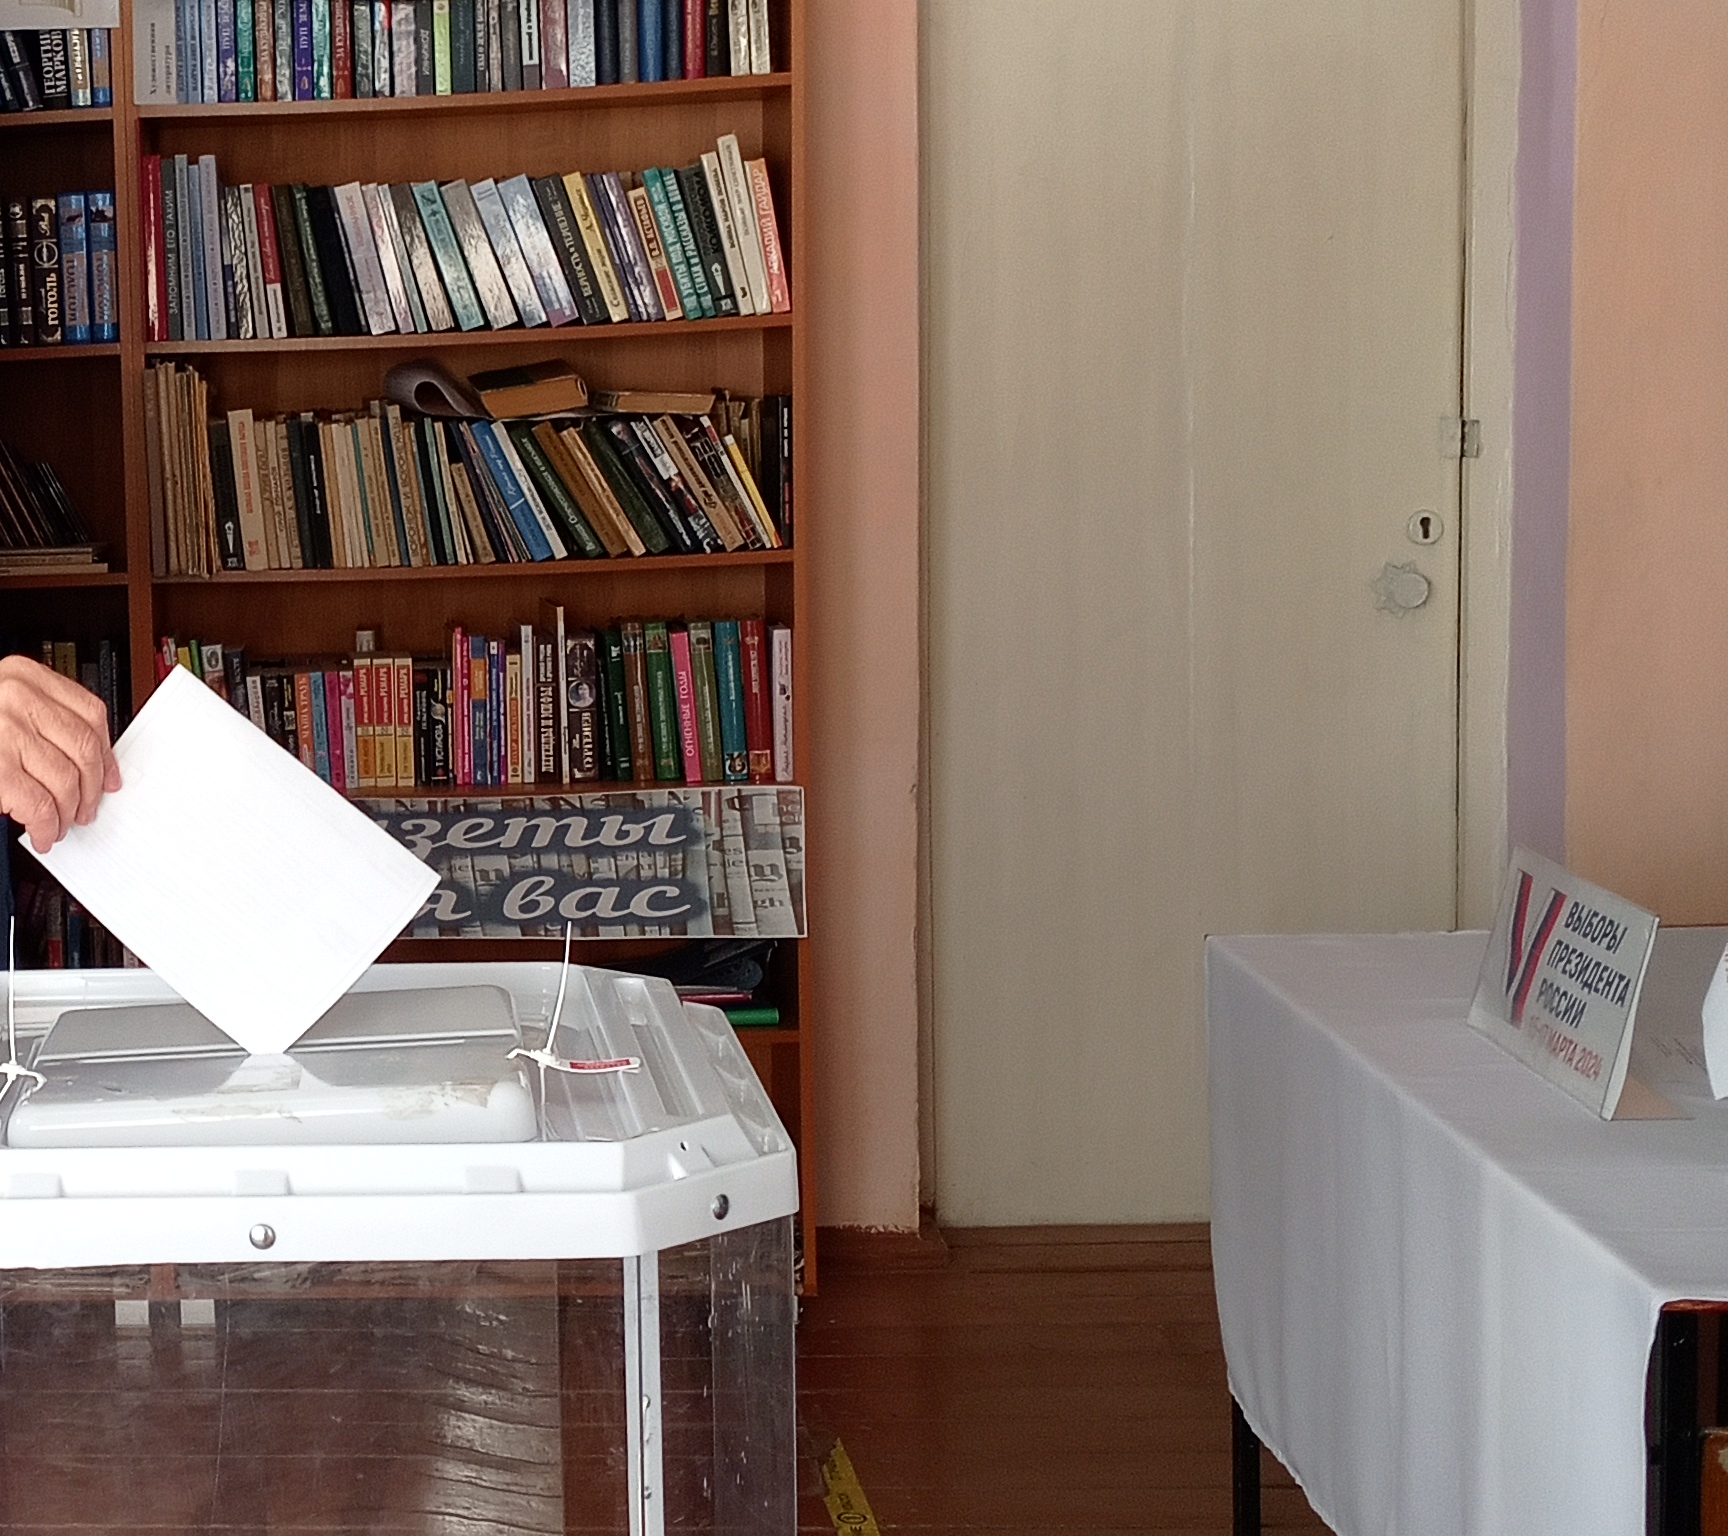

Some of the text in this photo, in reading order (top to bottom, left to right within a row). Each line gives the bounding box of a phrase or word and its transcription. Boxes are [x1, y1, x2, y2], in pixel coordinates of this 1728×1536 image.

[50, 29, 68, 94] МАРКОВ
[299, 26, 309, 49] ПУП
[549, 199, 576, 248] ТЕРПЕНИЕ
[672, 209, 697, 258] РАССКАЗЫ
[749, 165, 783, 276] АРКАДИЙ ГАЙДАР
[162, 188, 182, 314] ЗАПОМНИМ ЕГО ТАКИМ
[654, 201, 694, 296] УБИТЫ ПОД МОСКВОЙ
[45, 272, 58, 325] ГОГОЛЬ
[689, 263, 709, 294] СТИХИ
[359, 667, 367, 696] РЕМАРК
[378, 666, 388, 696] РЕМАРК
[397, 667, 408, 698] РЕМАРК
[538, 685, 556, 773] ЛЕГЕНДЫ И МИФЫ
[677, 670, 695, 757] ОГНЕННЫЕ ГОДЫ
[434, 723, 444, 761] УСТИНОВА
[581, 711, 593, 770] ТУРГЕНЕВ
[382, 812, 689, 862] зеты
[502, 875, 692, 921] вас
[1564, 901, 1627, 955] ВЫБОРЫ
[1546, 939, 1632, 1007] ПРЕЗИДЕНТА
[1535, 977, 1588, 1029] РОССИИ
